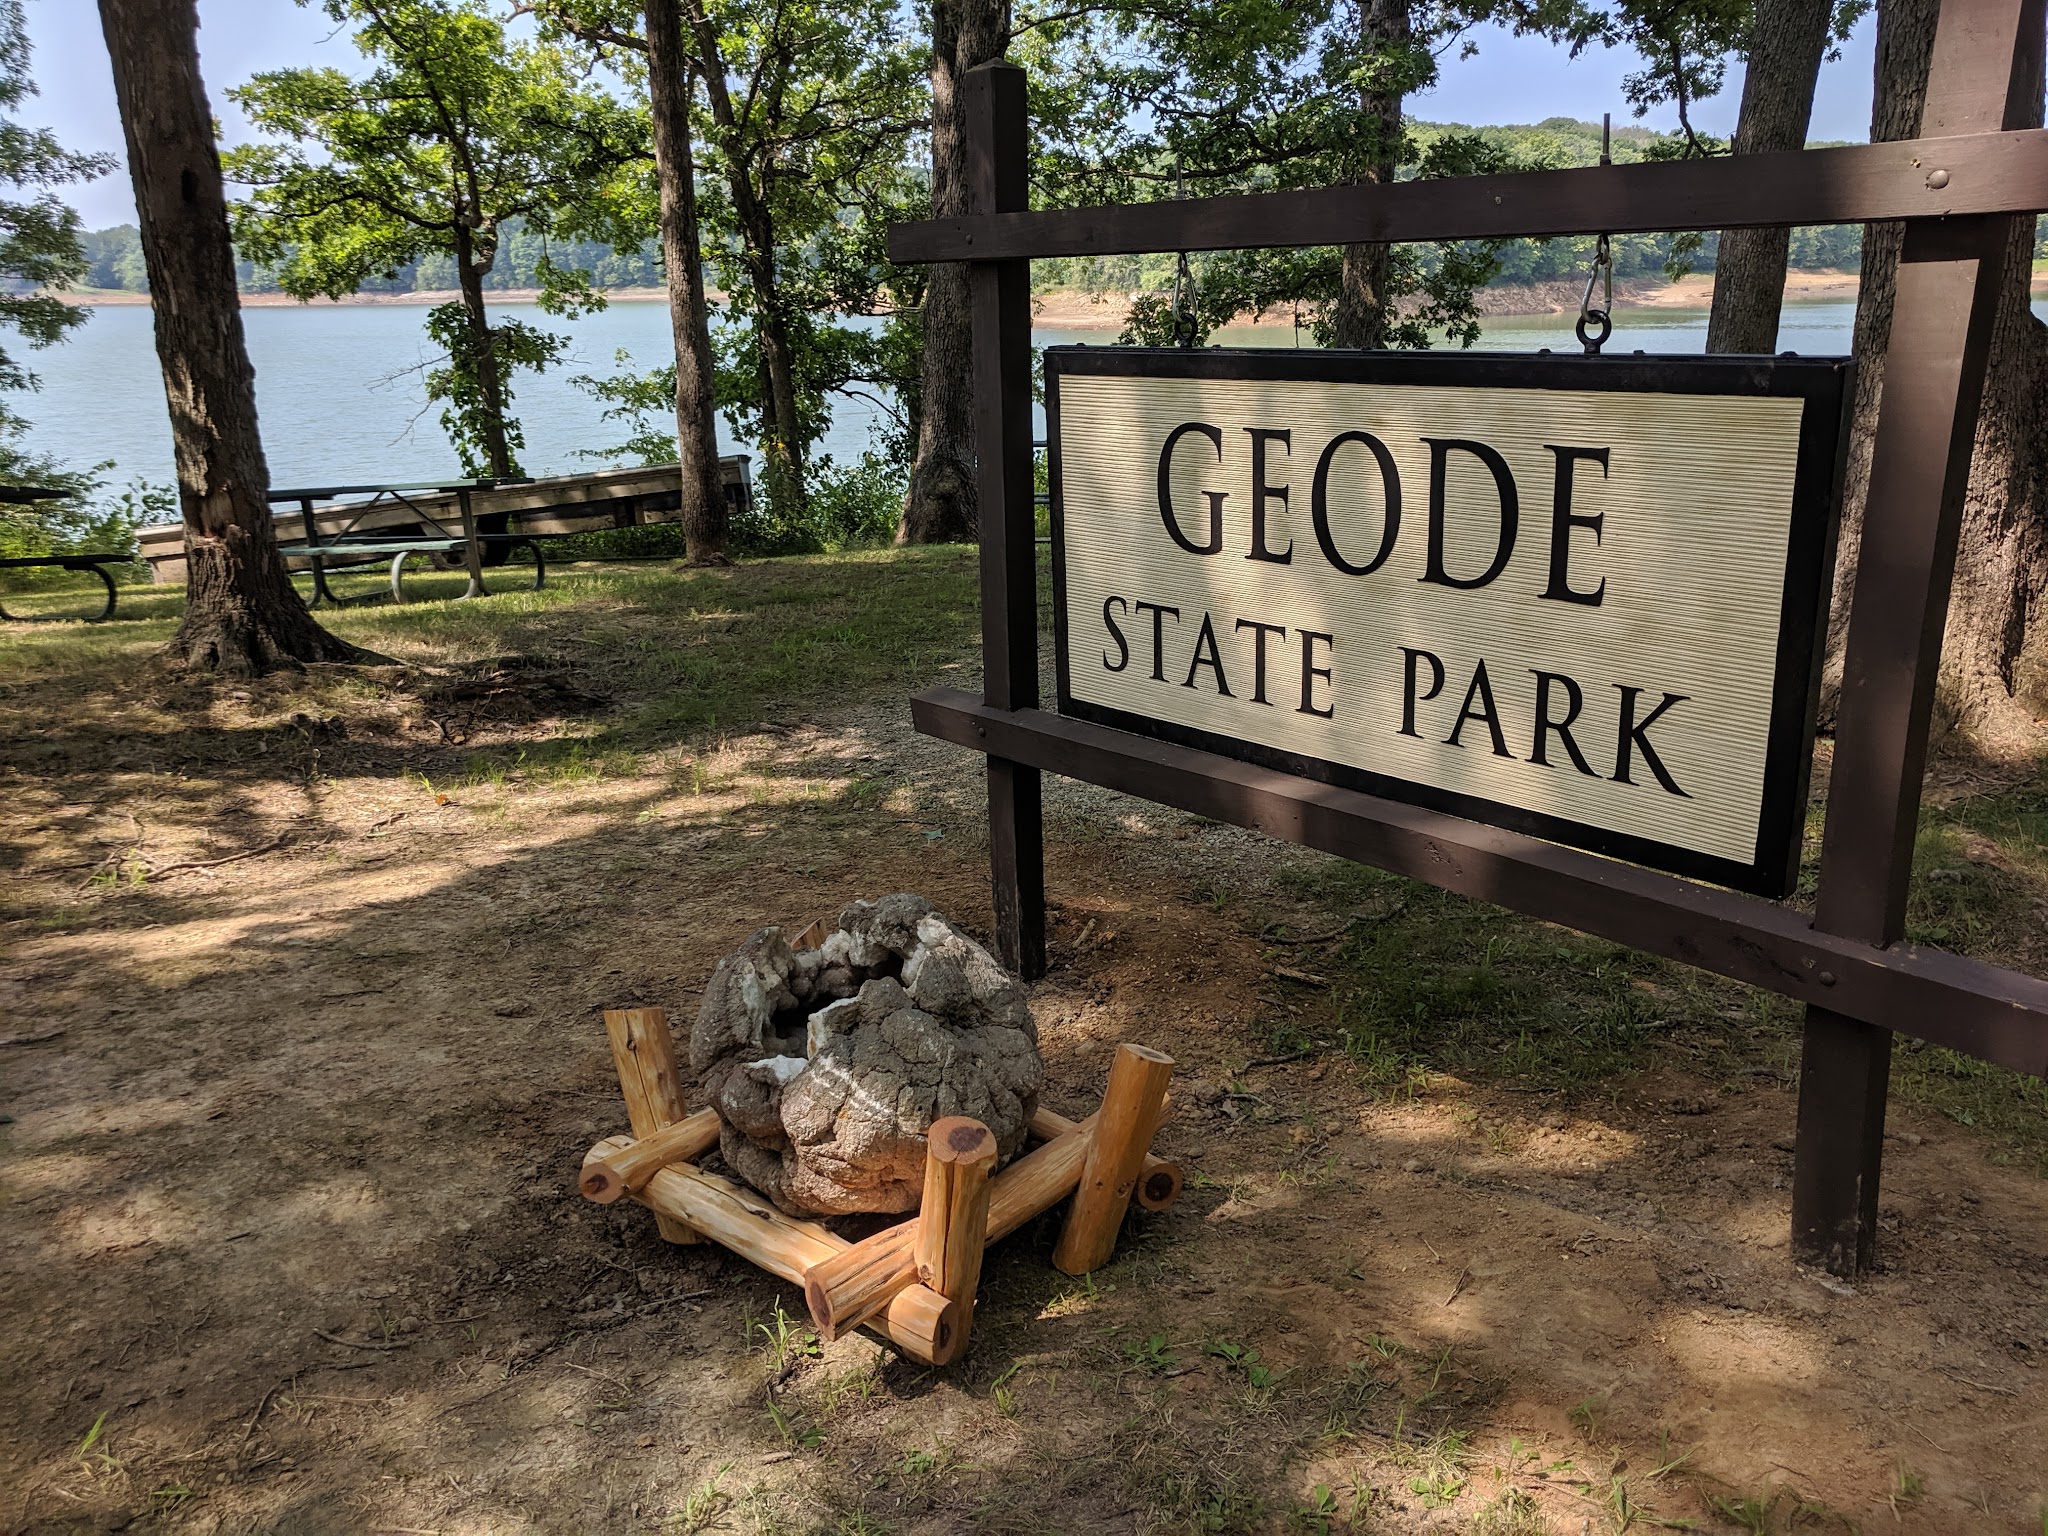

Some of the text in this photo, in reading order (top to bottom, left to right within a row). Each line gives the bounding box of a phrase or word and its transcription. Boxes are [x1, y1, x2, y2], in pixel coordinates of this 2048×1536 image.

[1157, 421, 1610, 607] GEODE
[1102, 595, 1695, 799] STATE PARK
